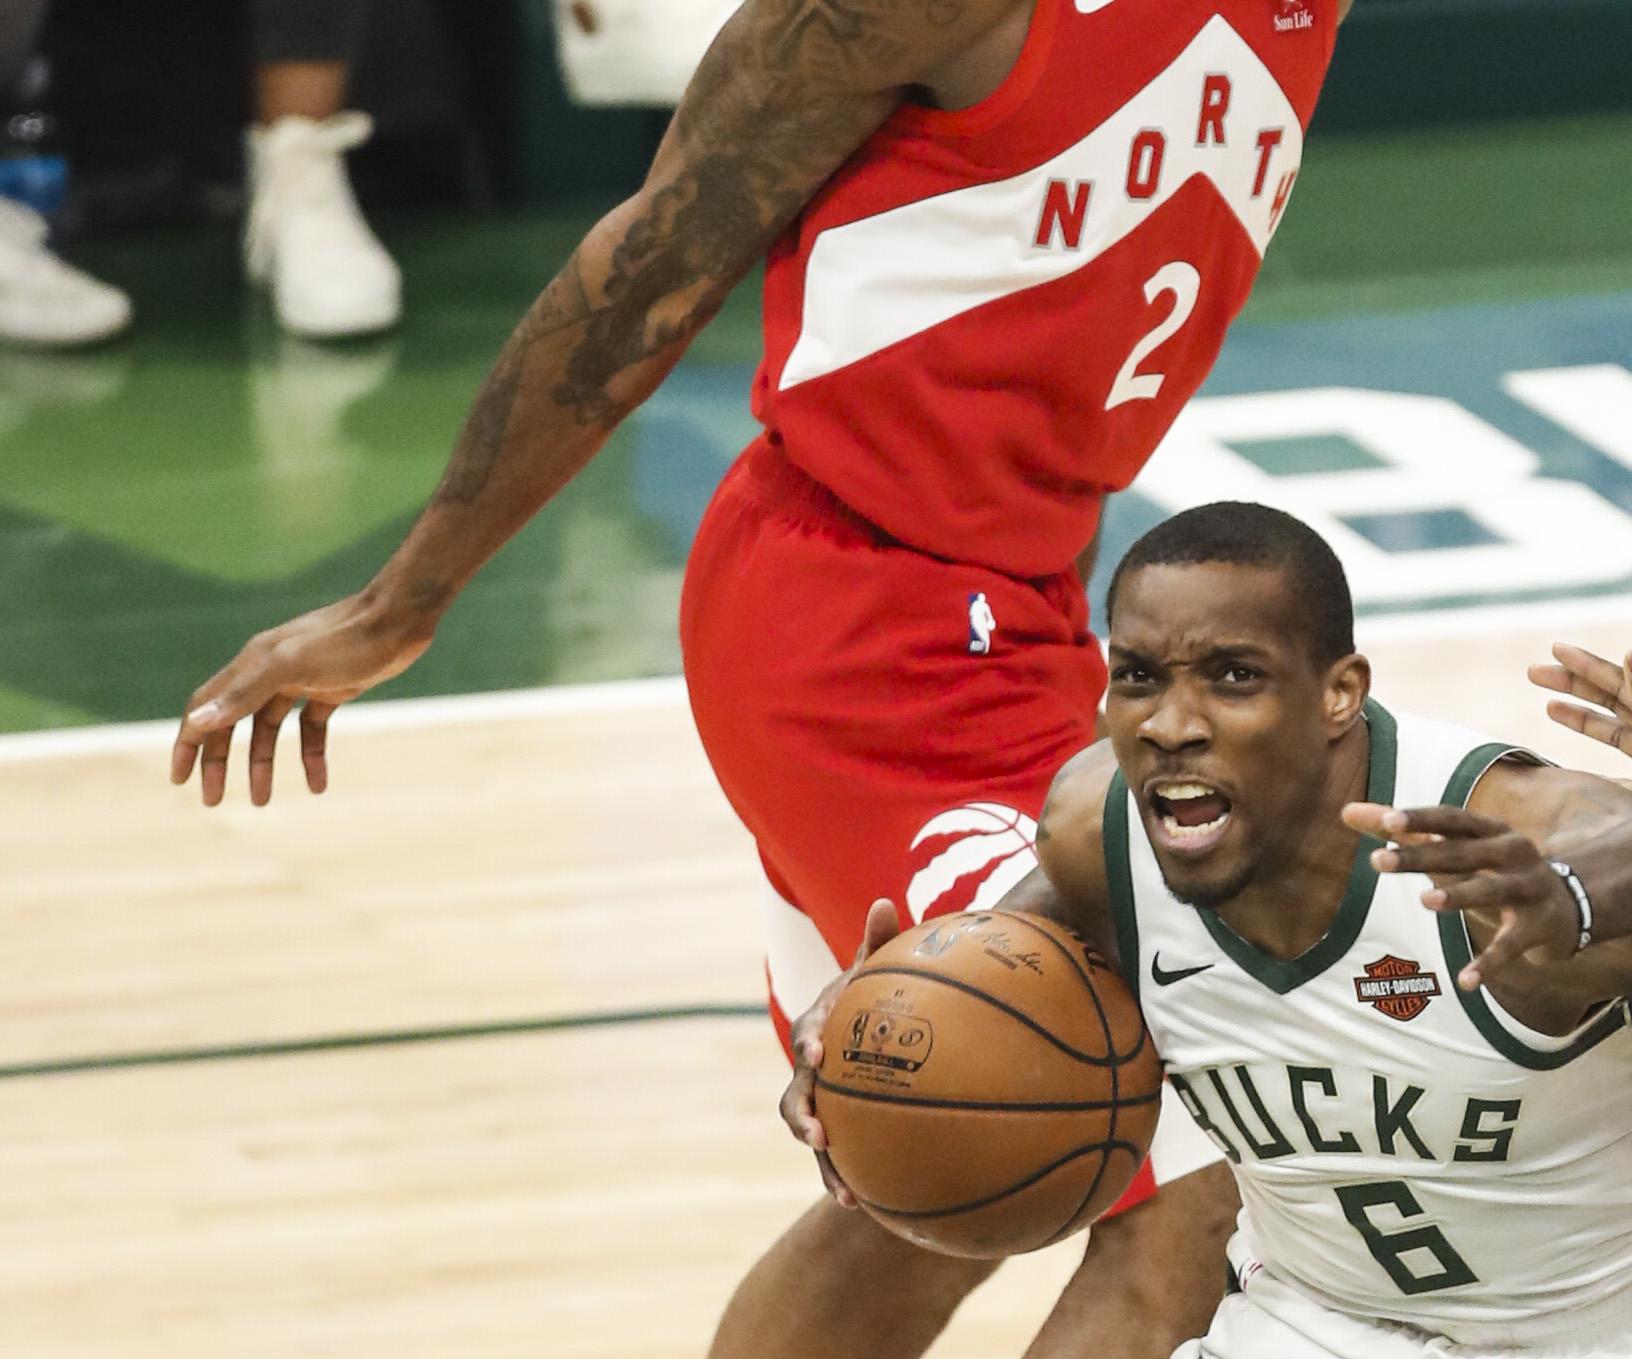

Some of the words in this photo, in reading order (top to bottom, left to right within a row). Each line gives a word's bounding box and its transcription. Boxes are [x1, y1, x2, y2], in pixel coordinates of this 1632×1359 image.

[1273, 14, 1293, 31] Sun
[1294, 9, 1314, 29] Life
[1031, 71, 1297, 252] NORTH
[1105, 260, 1201, 411] 2
[1360, 977, 1436, 997] HARLEY-DAVIDSON
[1168, 1062, 1523, 1165] BUCKS
[1333, 1180, 1481, 1297] 6
